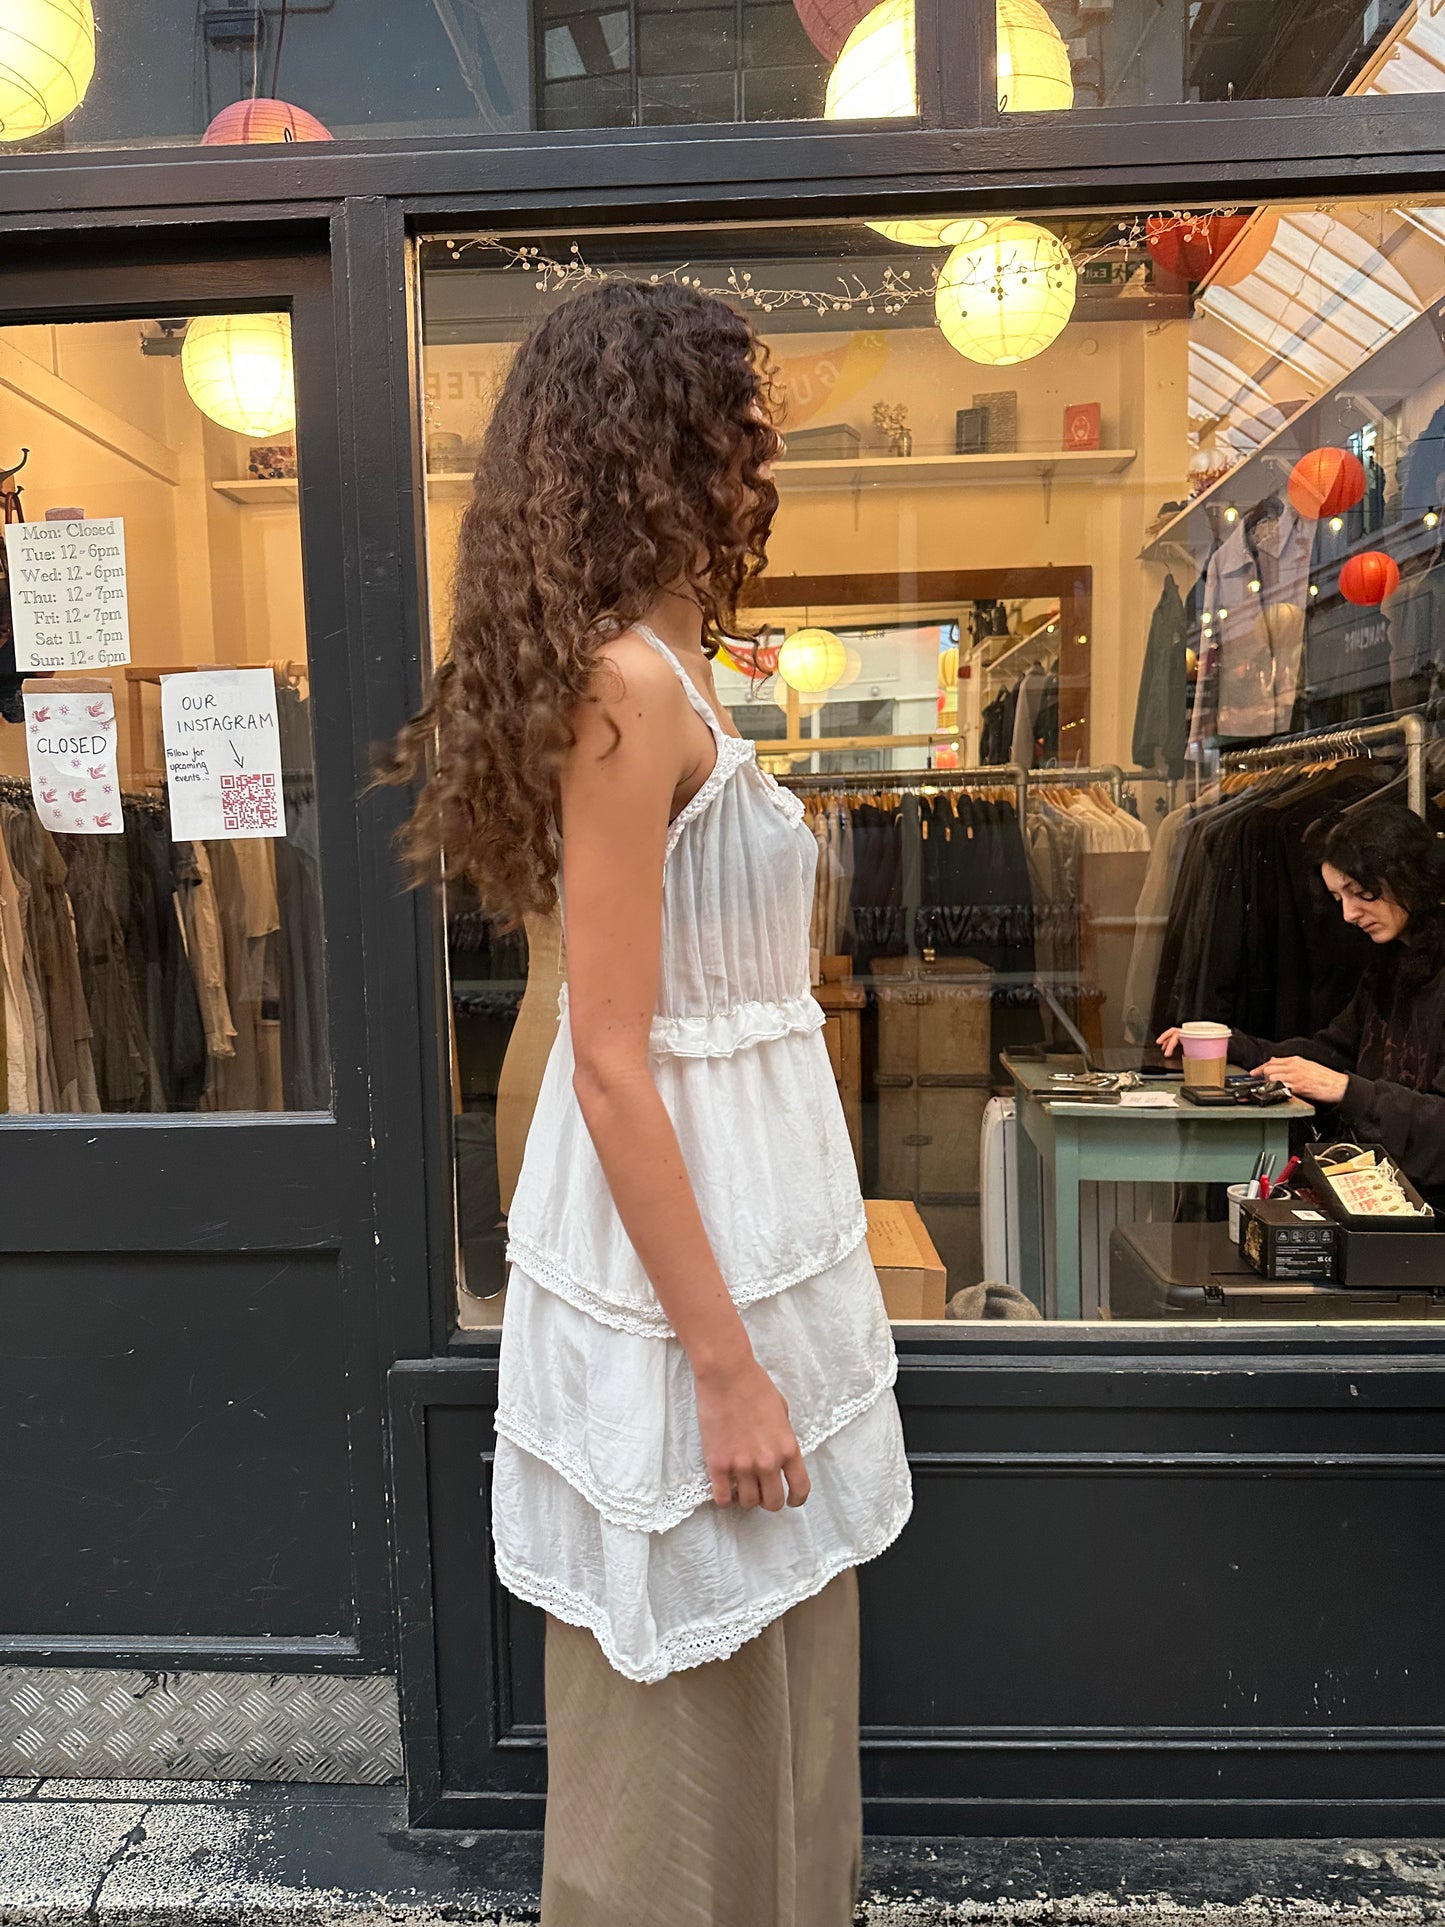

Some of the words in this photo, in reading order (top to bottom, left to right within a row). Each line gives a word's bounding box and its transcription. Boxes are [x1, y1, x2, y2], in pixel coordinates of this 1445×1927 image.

[22, 526, 61, 540] Mon:
[66, 521, 115, 537] Closed
[21, 548, 55, 561] Tue:
[20, 568, 62, 582] Wed:
[19, 590, 57, 604] Thu:
[33, 611, 60, 625] Fri:
[35, 632, 63, 646] Sat:
[30, 653, 65, 667] Sun:
[181, 694, 217, 711] OUR
[177, 713, 274, 733] INSTAGRAM
[36, 735, 107, 756] CLOSED
[166, 748, 189, 758] Follow
[192, 747, 205, 762] for
[169, 761, 209, 775] upcoming
